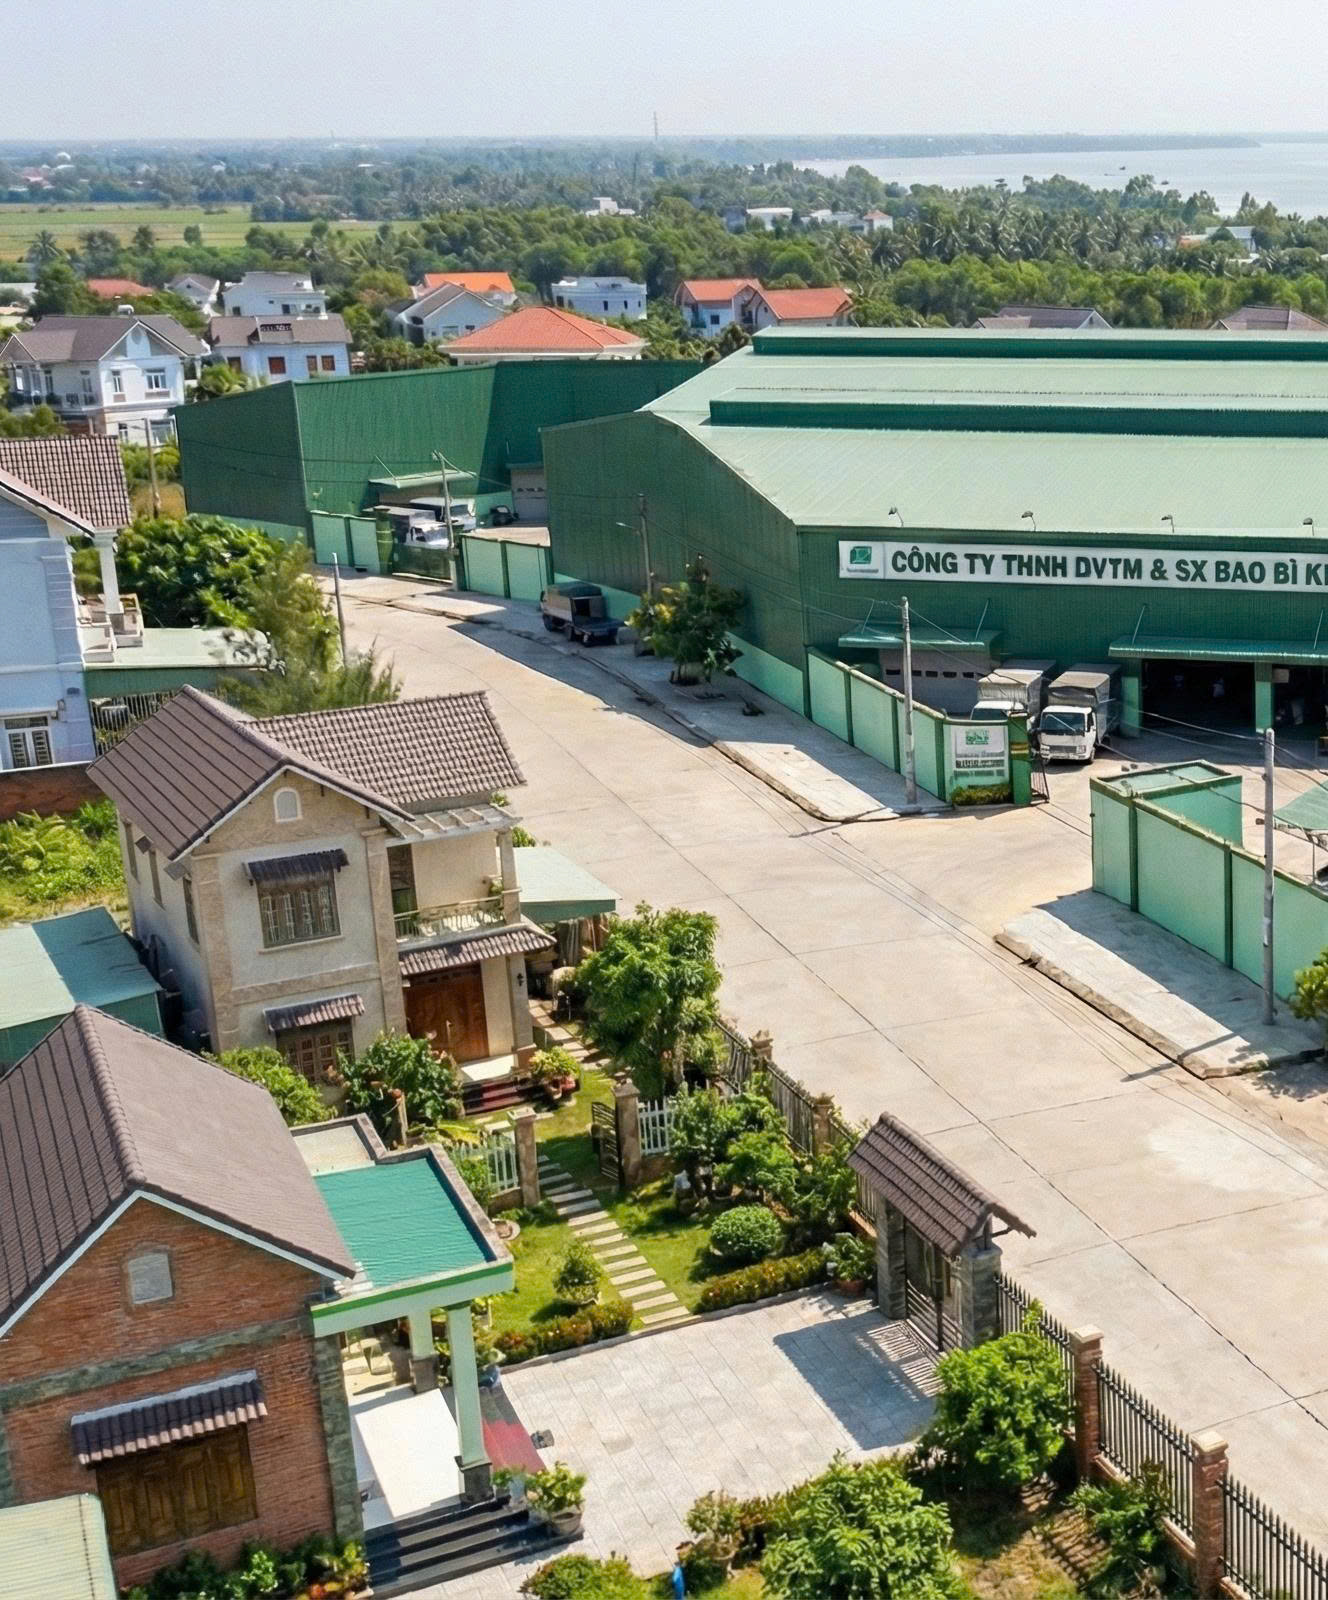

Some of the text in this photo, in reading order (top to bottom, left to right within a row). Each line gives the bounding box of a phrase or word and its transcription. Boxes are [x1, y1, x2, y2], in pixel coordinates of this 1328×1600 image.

[891, 545, 959, 575] CÔNG
[963, 552, 996, 576] TY
[1001, 553, 1068, 578] THNH
[1074, 555, 1143, 580] DVTM
[1149, 558, 1169, 581] &
[1175, 558, 1209, 583] SX
[1214, 560, 1267, 584] BAO
[1273, 557, 1298, 585] BÌ
